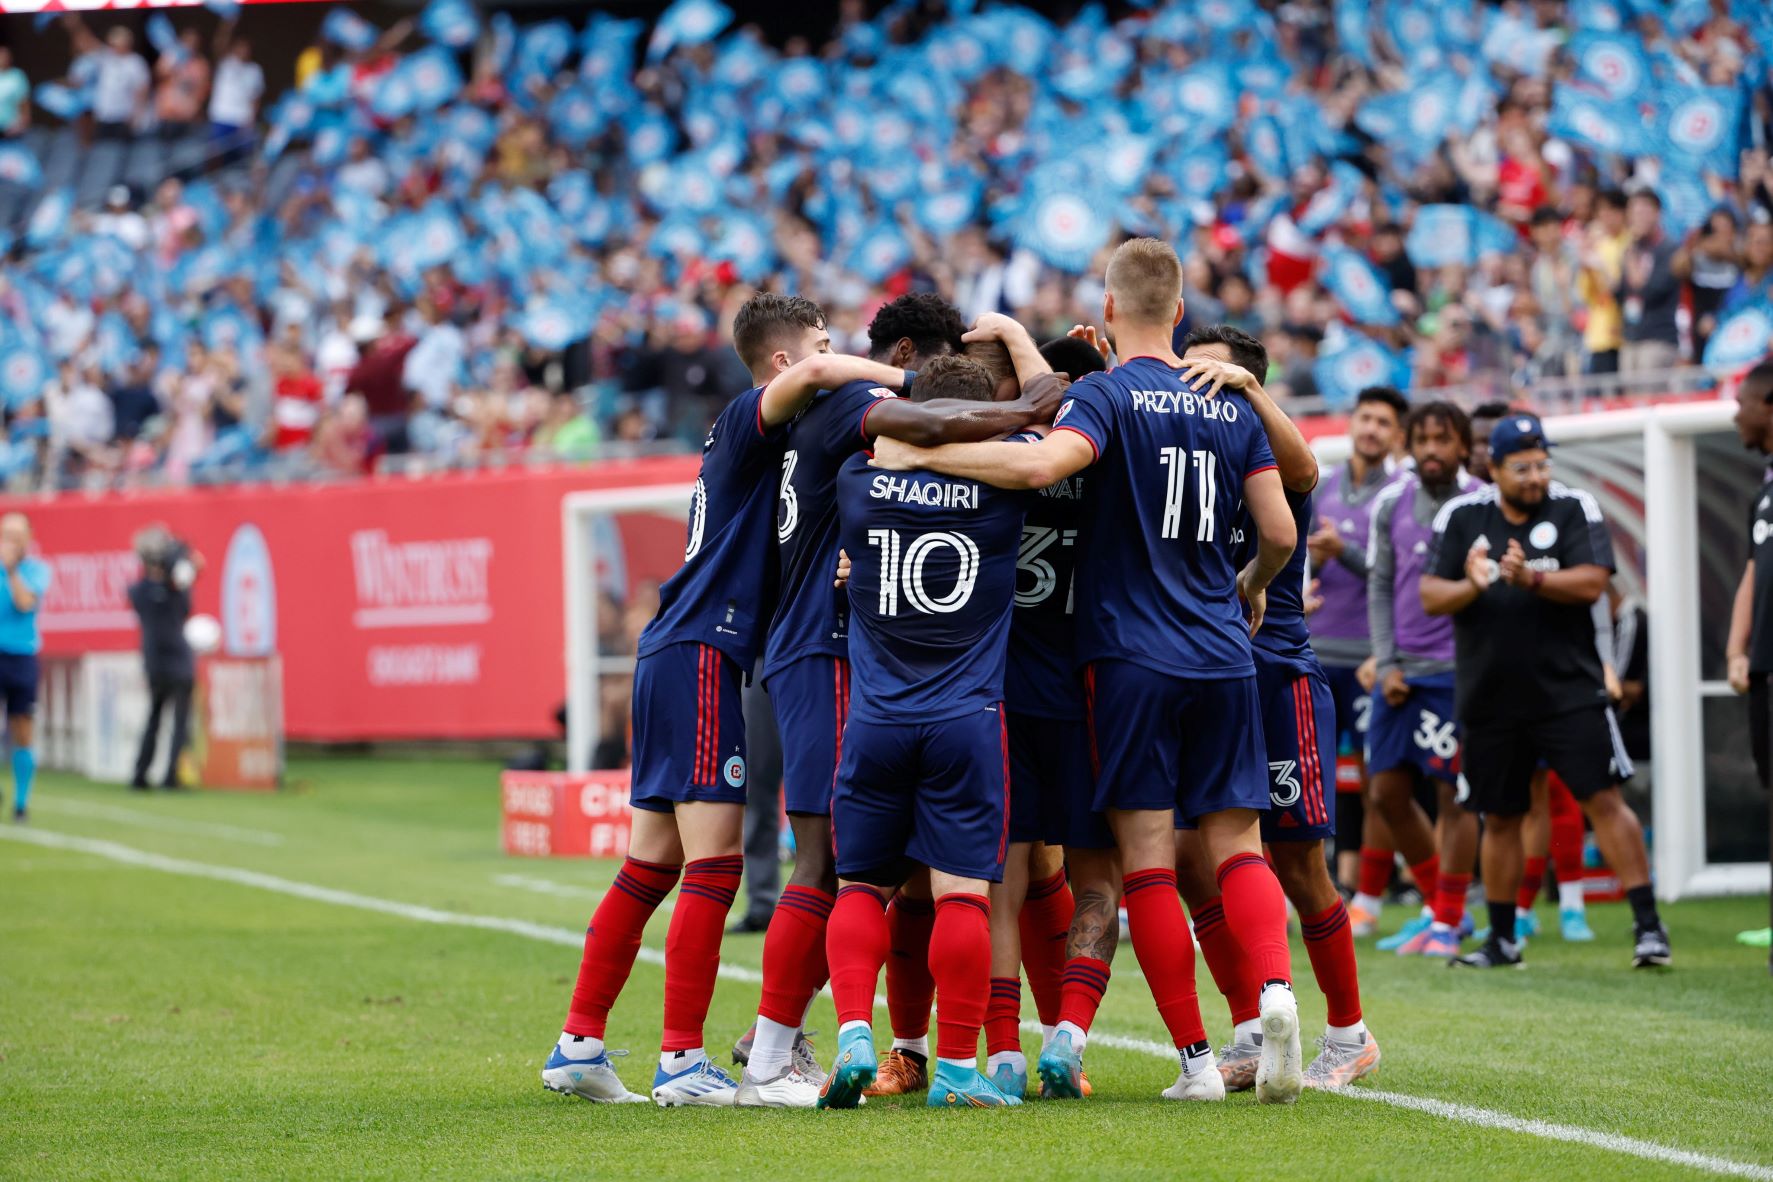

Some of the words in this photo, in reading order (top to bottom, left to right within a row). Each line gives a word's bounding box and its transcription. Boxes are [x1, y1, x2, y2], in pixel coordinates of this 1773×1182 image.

[869, 474, 979, 509] SHAQIRI
[1160, 447, 1216, 542] 11
[868, 529, 980, 616] 10
[1414, 709, 1459, 760] 36
[1269, 759, 1301, 807] 3
